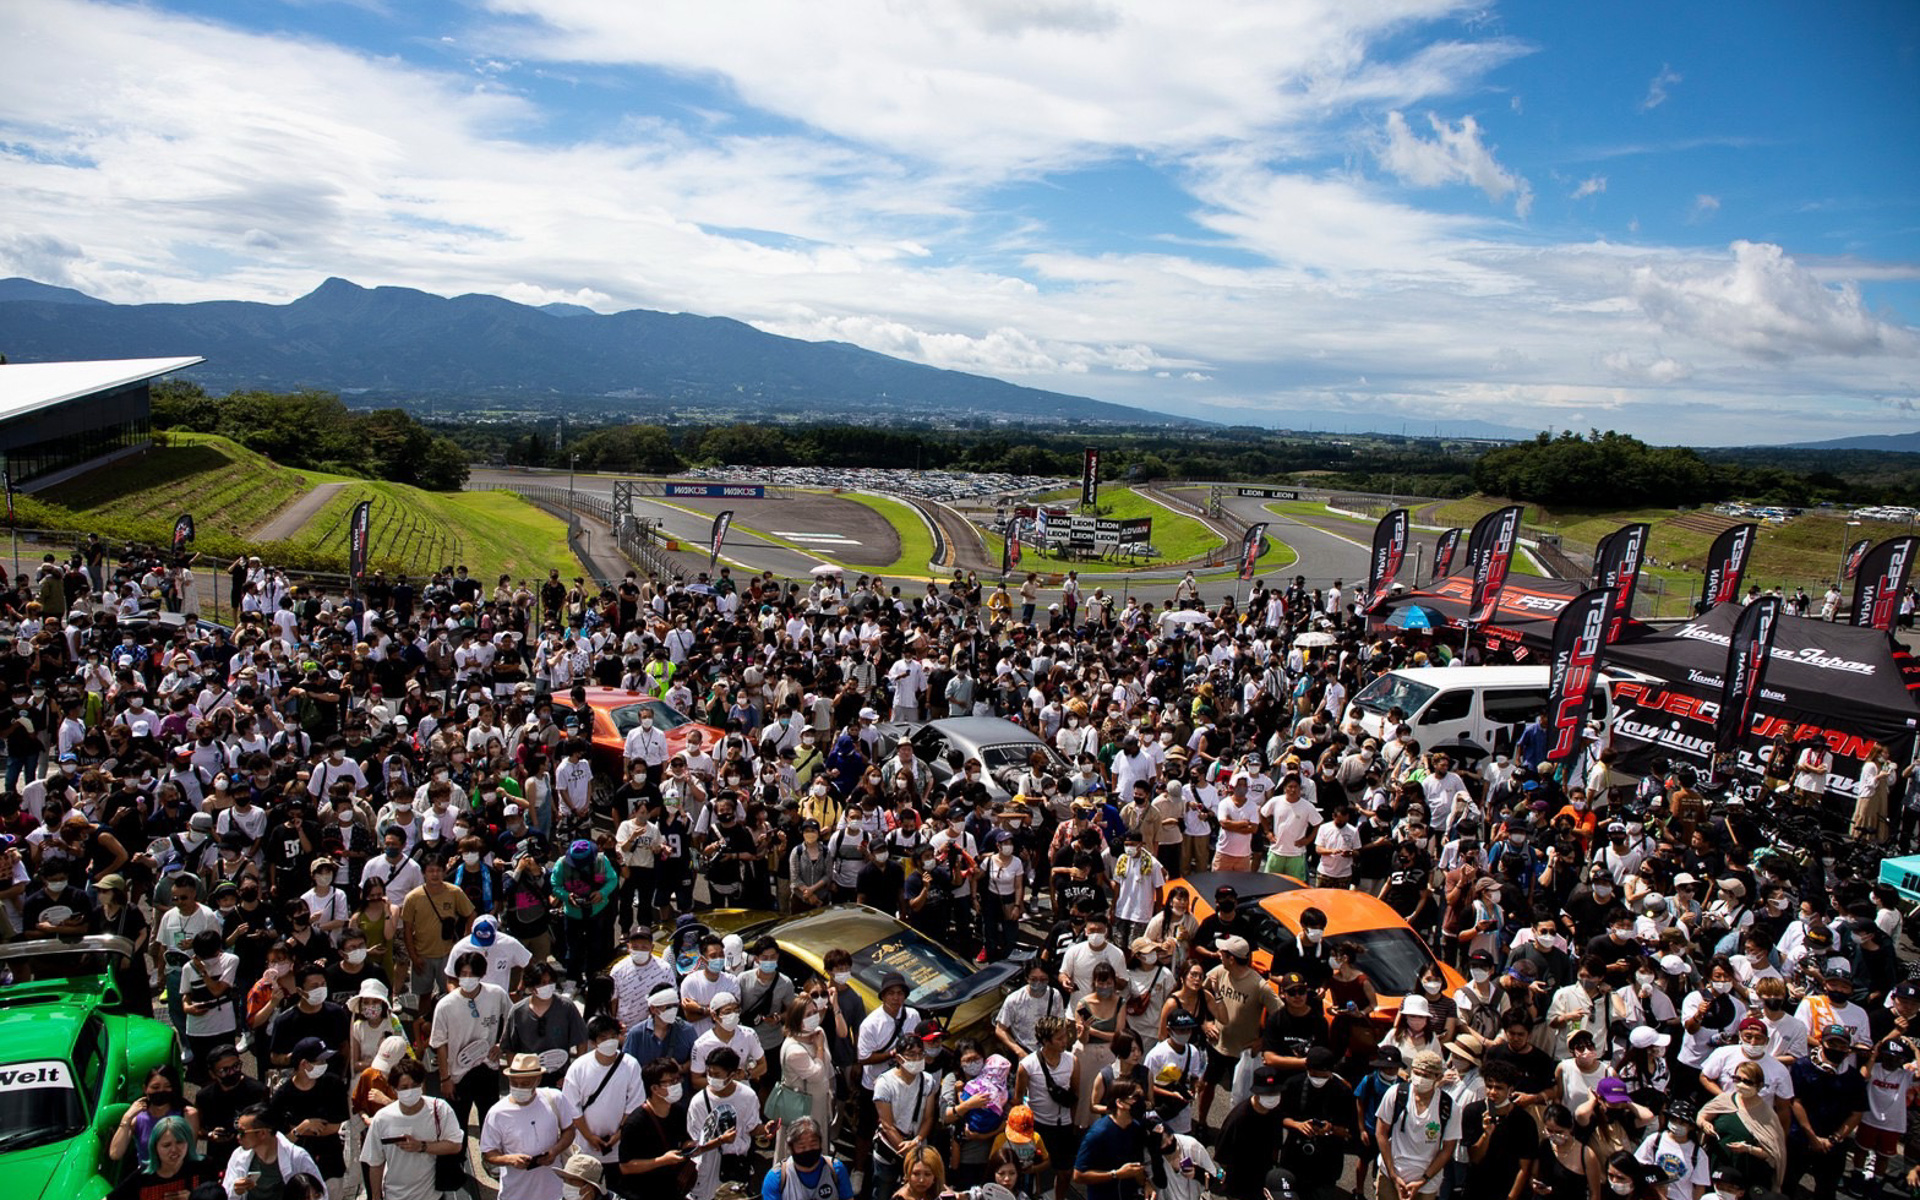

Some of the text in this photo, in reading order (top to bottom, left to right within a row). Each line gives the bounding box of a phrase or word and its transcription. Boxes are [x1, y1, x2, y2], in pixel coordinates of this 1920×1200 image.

[1242, 489, 1294, 499] LEON LEON
[1048, 516, 1070, 526] LEON
[1072, 519, 1095, 528] LEON
[1097, 521, 1119, 529] LEON
[1047, 530, 1070, 538] LEON
[1121, 526, 1148, 536] ADVAN
[1071, 532, 1094, 540] LEON
[1095, 533, 1118, 541] LEON
[1793, 648, 1876, 676] Japan
[1221, 985, 1248, 1004] ARMY
